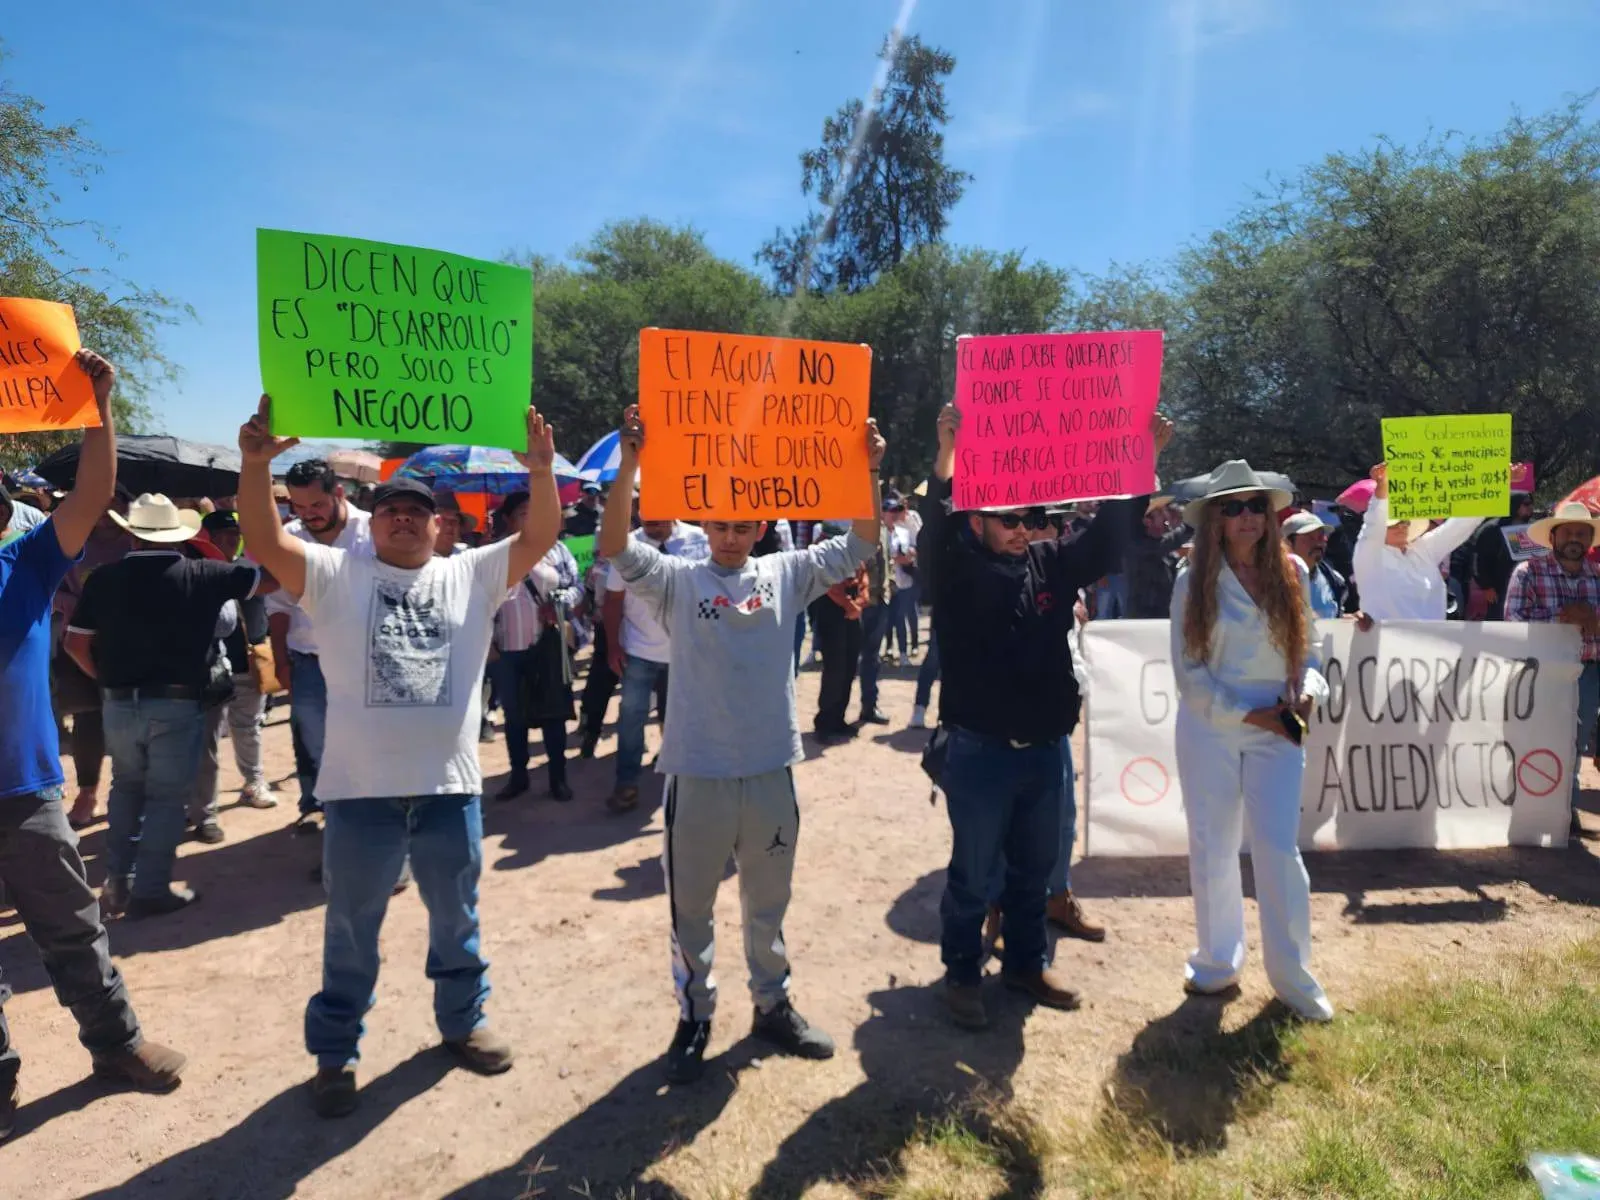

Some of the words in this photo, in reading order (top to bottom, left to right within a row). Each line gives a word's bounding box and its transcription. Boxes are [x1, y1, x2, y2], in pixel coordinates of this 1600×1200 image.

[304, 241, 418, 297] DICEN
[432, 260, 489, 305] QUE
[271, 298, 309, 339] ES
[305, 348, 379, 381] PERO
[398, 353, 453, 384] SOLO
[468, 356, 492, 385] ES
[711, 341, 777, 386] AGUA
[799, 348, 834, 385] NO
[962, 342, 975, 371] EL
[982, 346, 1016, 372] AGUA
[1021, 343, 1057, 371] DEBE
[1065, 339, 1136, 371] QUEDARSE
[0, 376, 63, 408] ILPA
[972, 378, 1023, 405] DONDE
[1036, 374, 1055, 402] SE
[1062, 374, 1122, 401] CULTIVA
[333, 388, 473, 434] NEGOCIO
[660, 389, 740, 426] TIENE
[762, 393, 858, 431] PARTIDO,
[976, 413, 996, 438] LA
[1002, 410, 1050, 437] VIDA,
[1059, 408, 1082, 435] NO
[1089, 406, 1138, 431] DONDE
[684, 432, 761, 468] TIENE
[776, 430, 844, 470] DUEÑO
[961, 449, 981, 479] SE
[992, 446, 1056, 476] FABRICA
[1064, 443, 1079, 468] EL
[1086, 435, 1145, 465] DINERO
[1386, 444, 1425, 460] Somos
[1451, 445, 1507, 460] municipios
[1430, 460, 1474, 473] Estado
[730, 476, 821, 511] PUEBLO
[1006, 482, 1021, 503] AL
[1393, 502, 1452, 518] Industrial
[1419, 493, 1433, 503] en
[1450, 489, 1502, 501] corredor
[380, 622, 439, 638] addas
[1358, 656, 1539, 723] CORRUPTO
[1317, 740, 1517, 812] ACUEDUCTO
